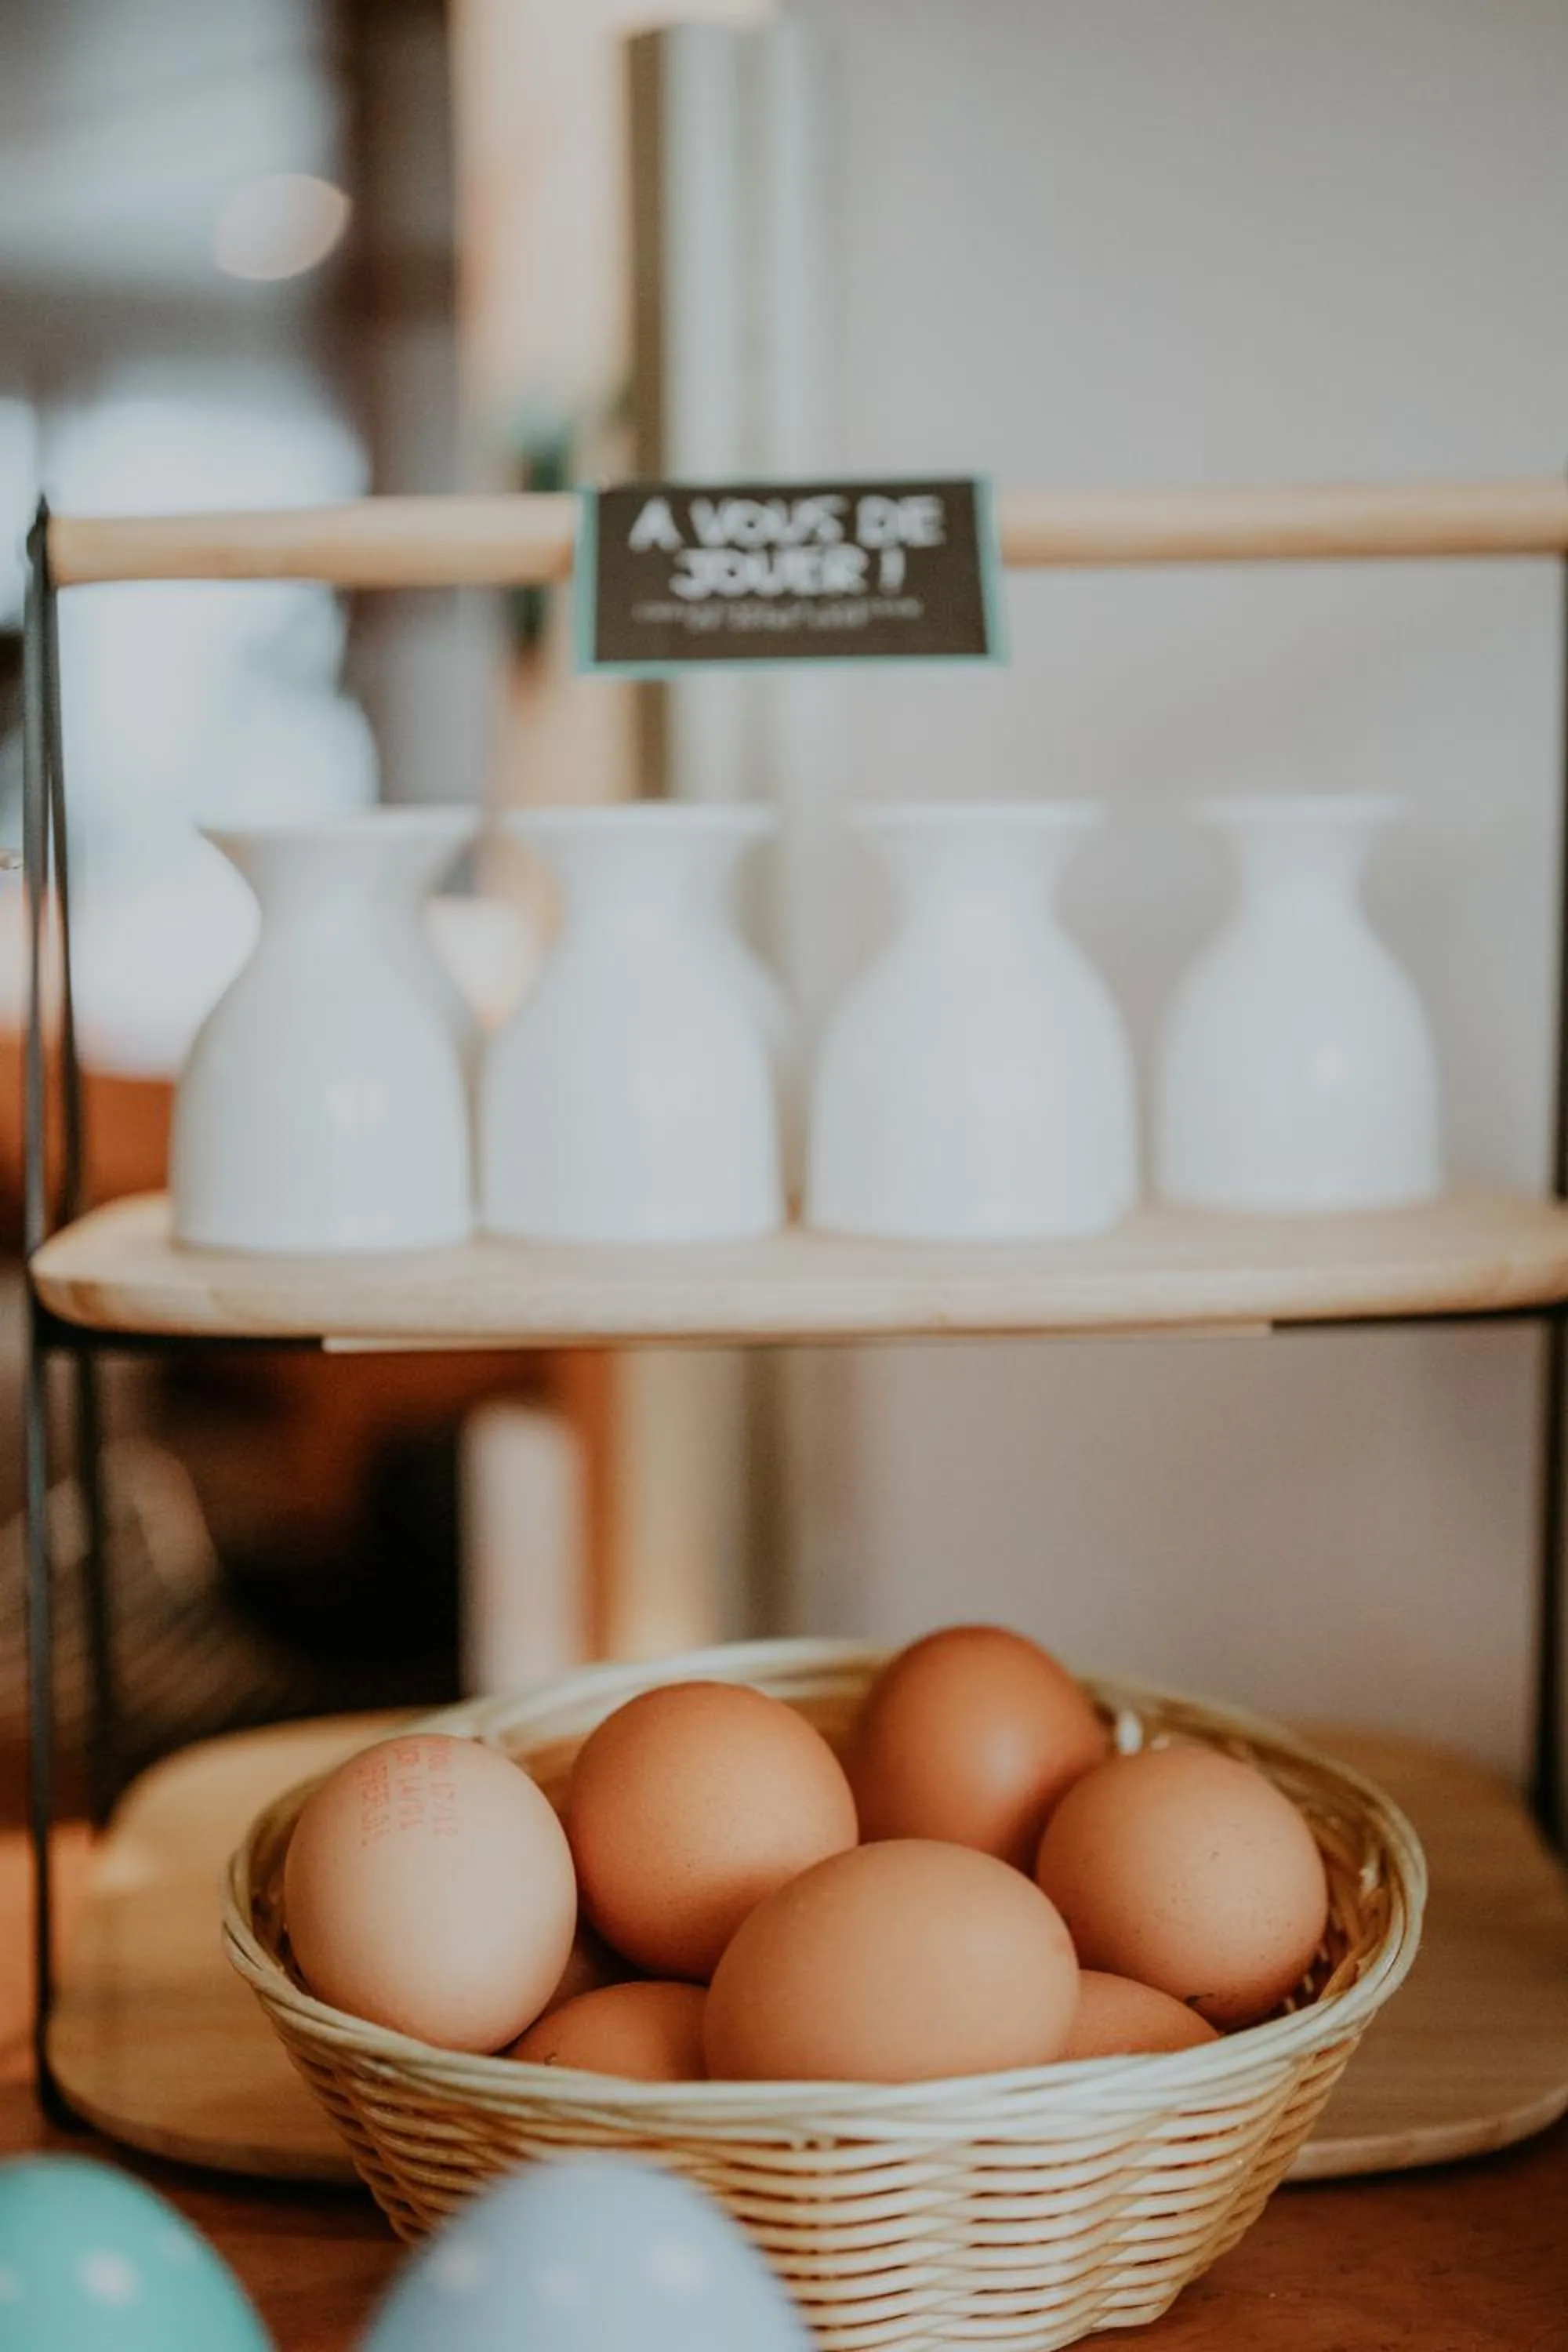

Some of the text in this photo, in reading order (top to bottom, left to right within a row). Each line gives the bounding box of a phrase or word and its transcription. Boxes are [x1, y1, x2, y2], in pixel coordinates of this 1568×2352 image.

[630, 494, 946, 552] A VOUS DE
[670, 546, 869, 601] JOUER
